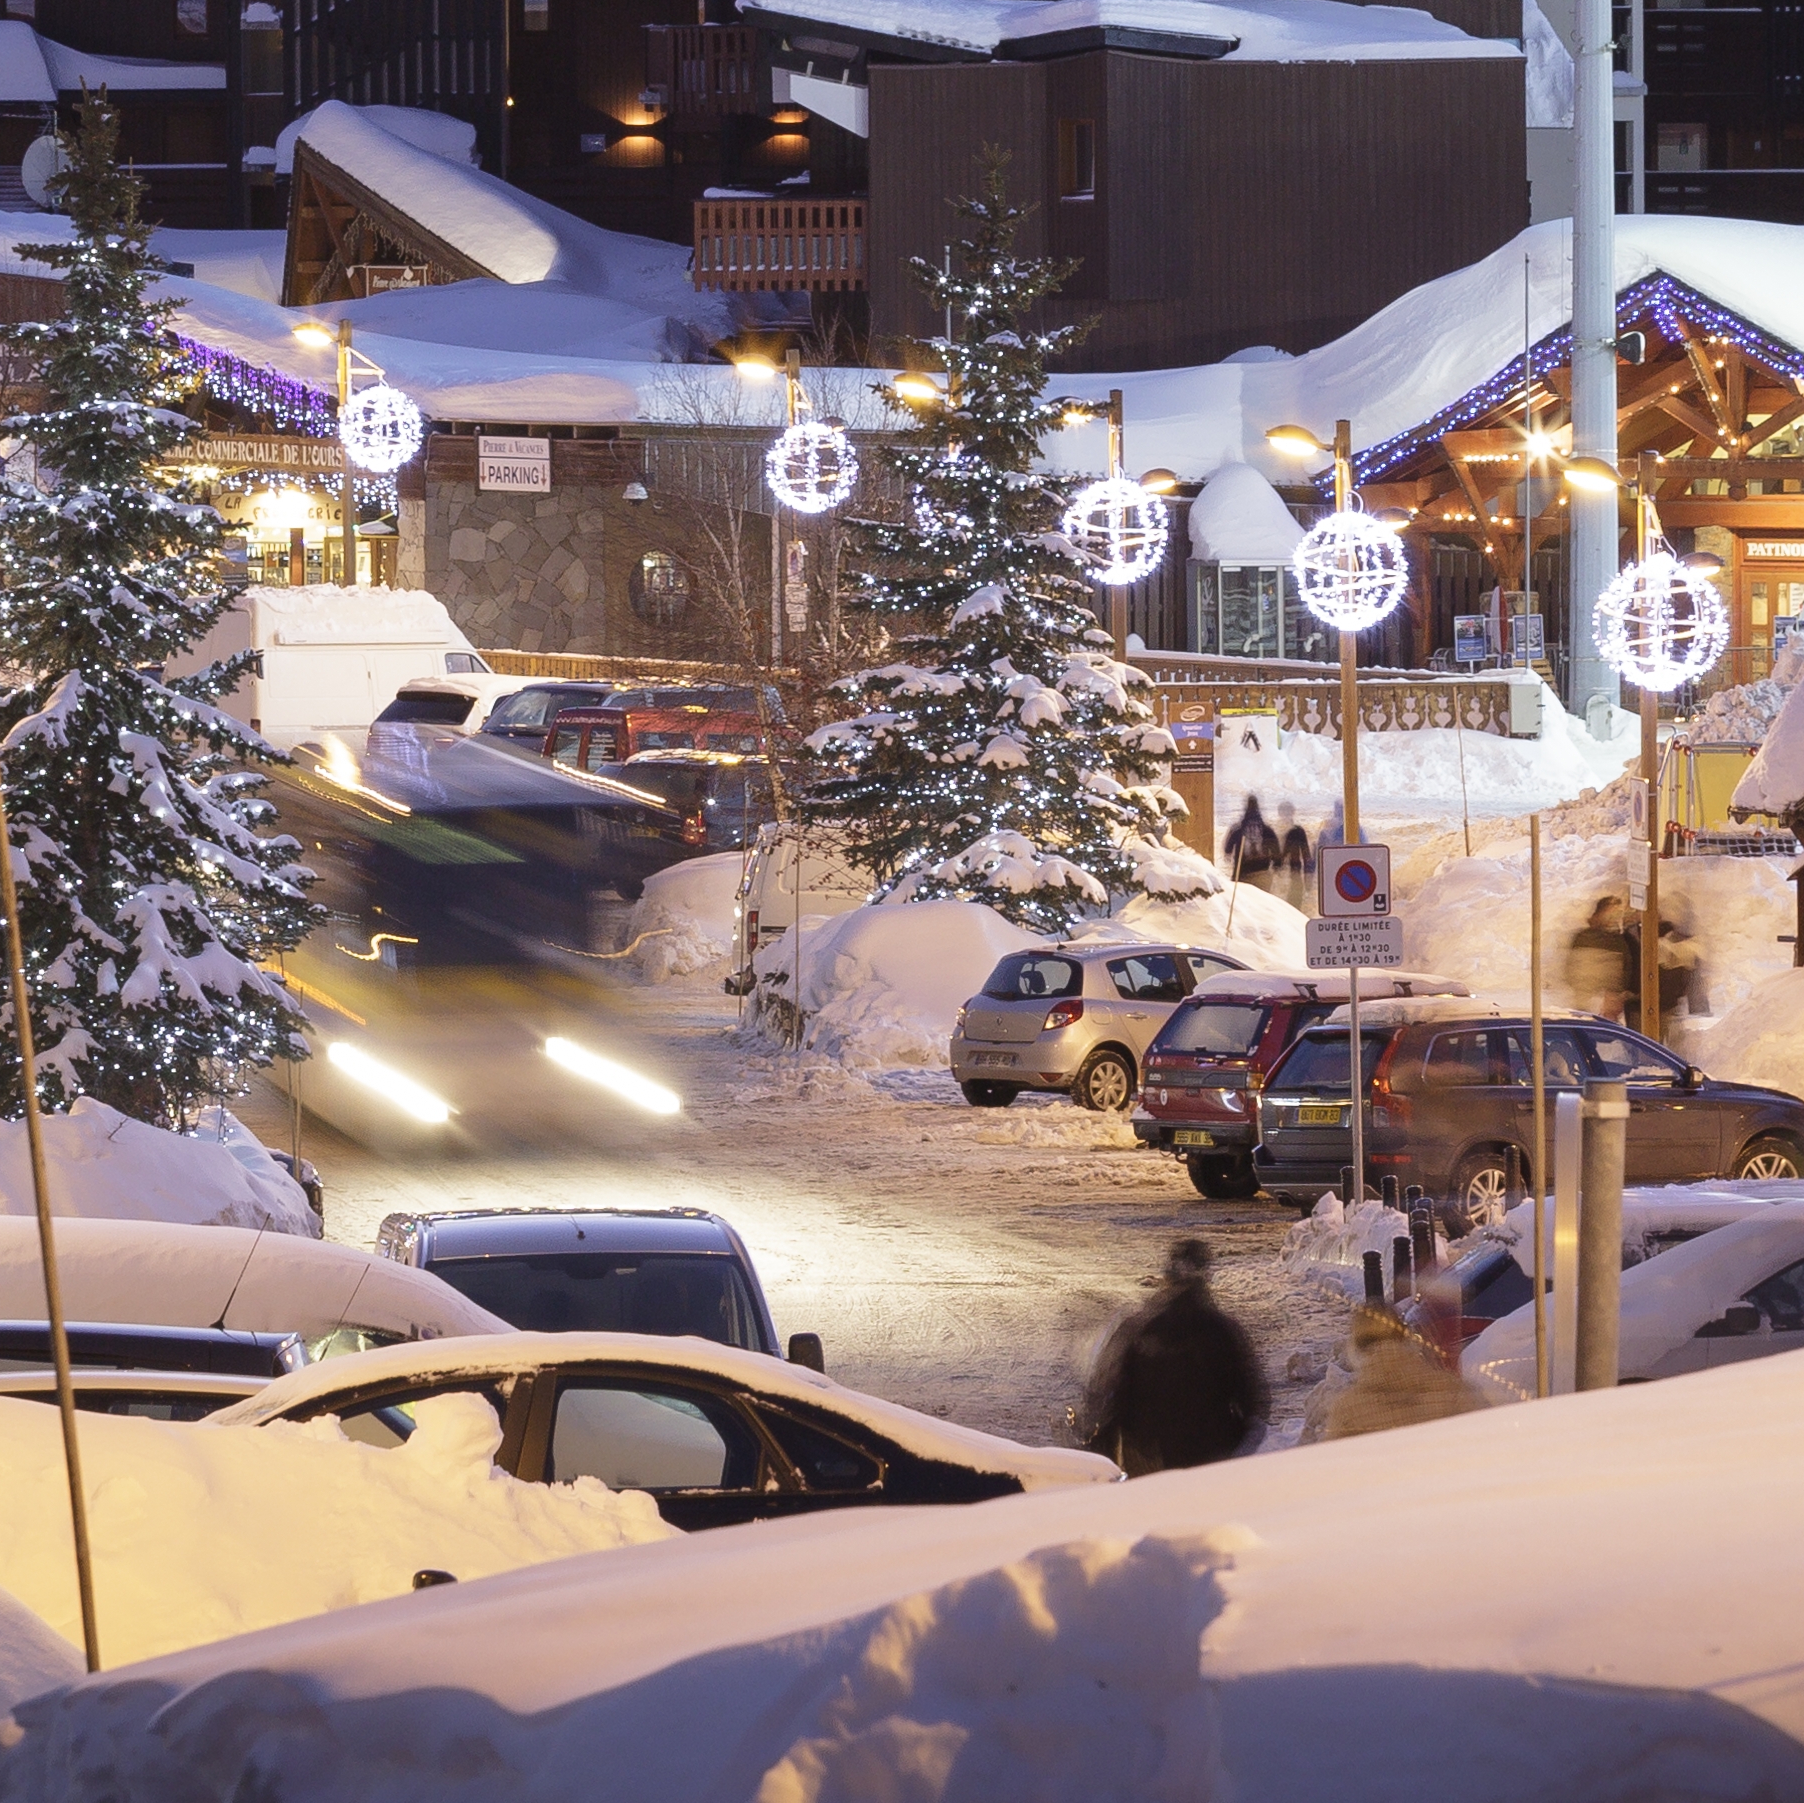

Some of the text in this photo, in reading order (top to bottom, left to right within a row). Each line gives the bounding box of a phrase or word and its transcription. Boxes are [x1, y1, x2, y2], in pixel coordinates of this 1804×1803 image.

[197, 439, 279, 464] COMMERCIALE
[283, 445, 299, 464] DE
[303, 444, 343, 467] L'OURS
[488, 466, 539, 484] PARKING
[224, 495, 242, 509] LA
[1318, 920, 1391, 931] DURÉE LIMITÉE
[1320, 946, 1332, 954] DE
[1310, 957, 1322, 966] ET
[1325, 957, 1337, 965] DE
